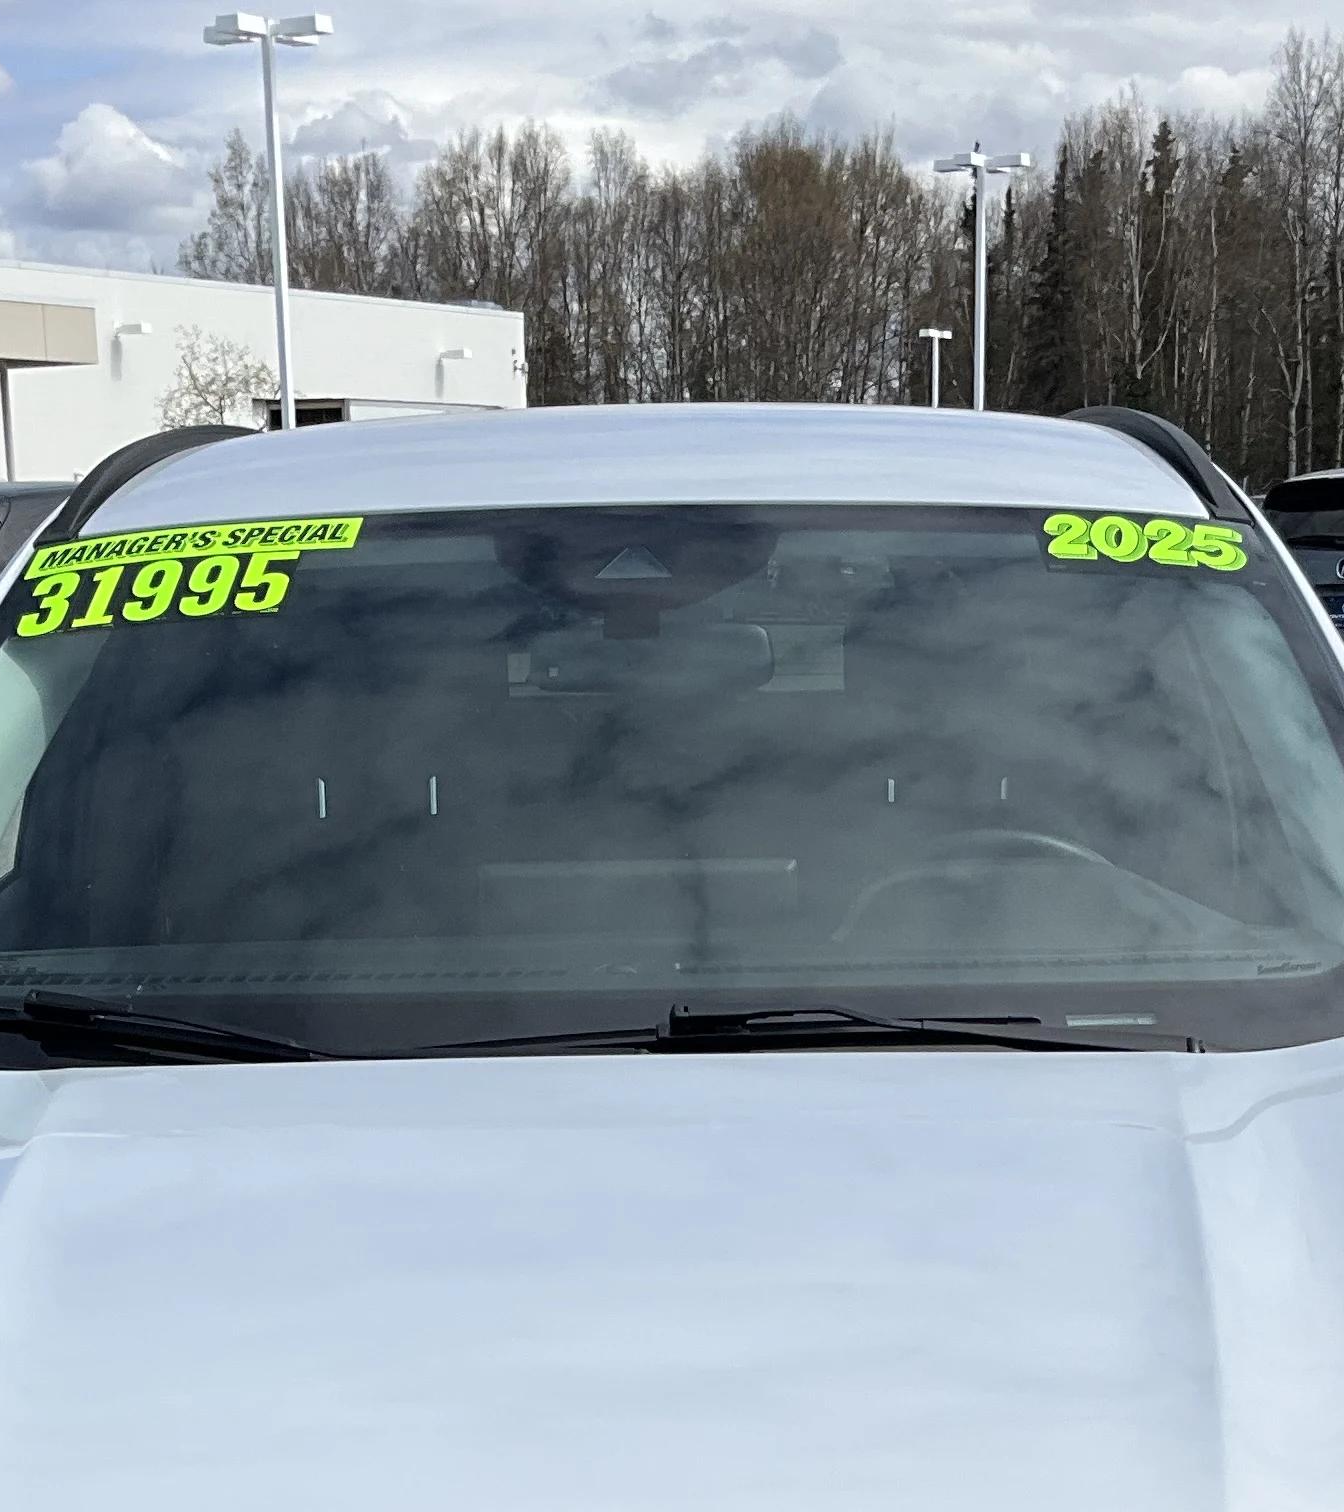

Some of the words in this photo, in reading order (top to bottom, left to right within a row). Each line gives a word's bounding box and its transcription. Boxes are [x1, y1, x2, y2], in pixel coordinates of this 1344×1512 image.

[37, 529, 220, 571] MANAGER'S
[223, 522, 350, 548] SPECIAL
[1043, 513, 1248, 571] 2025
[16, 550, 302, 637] 31995
